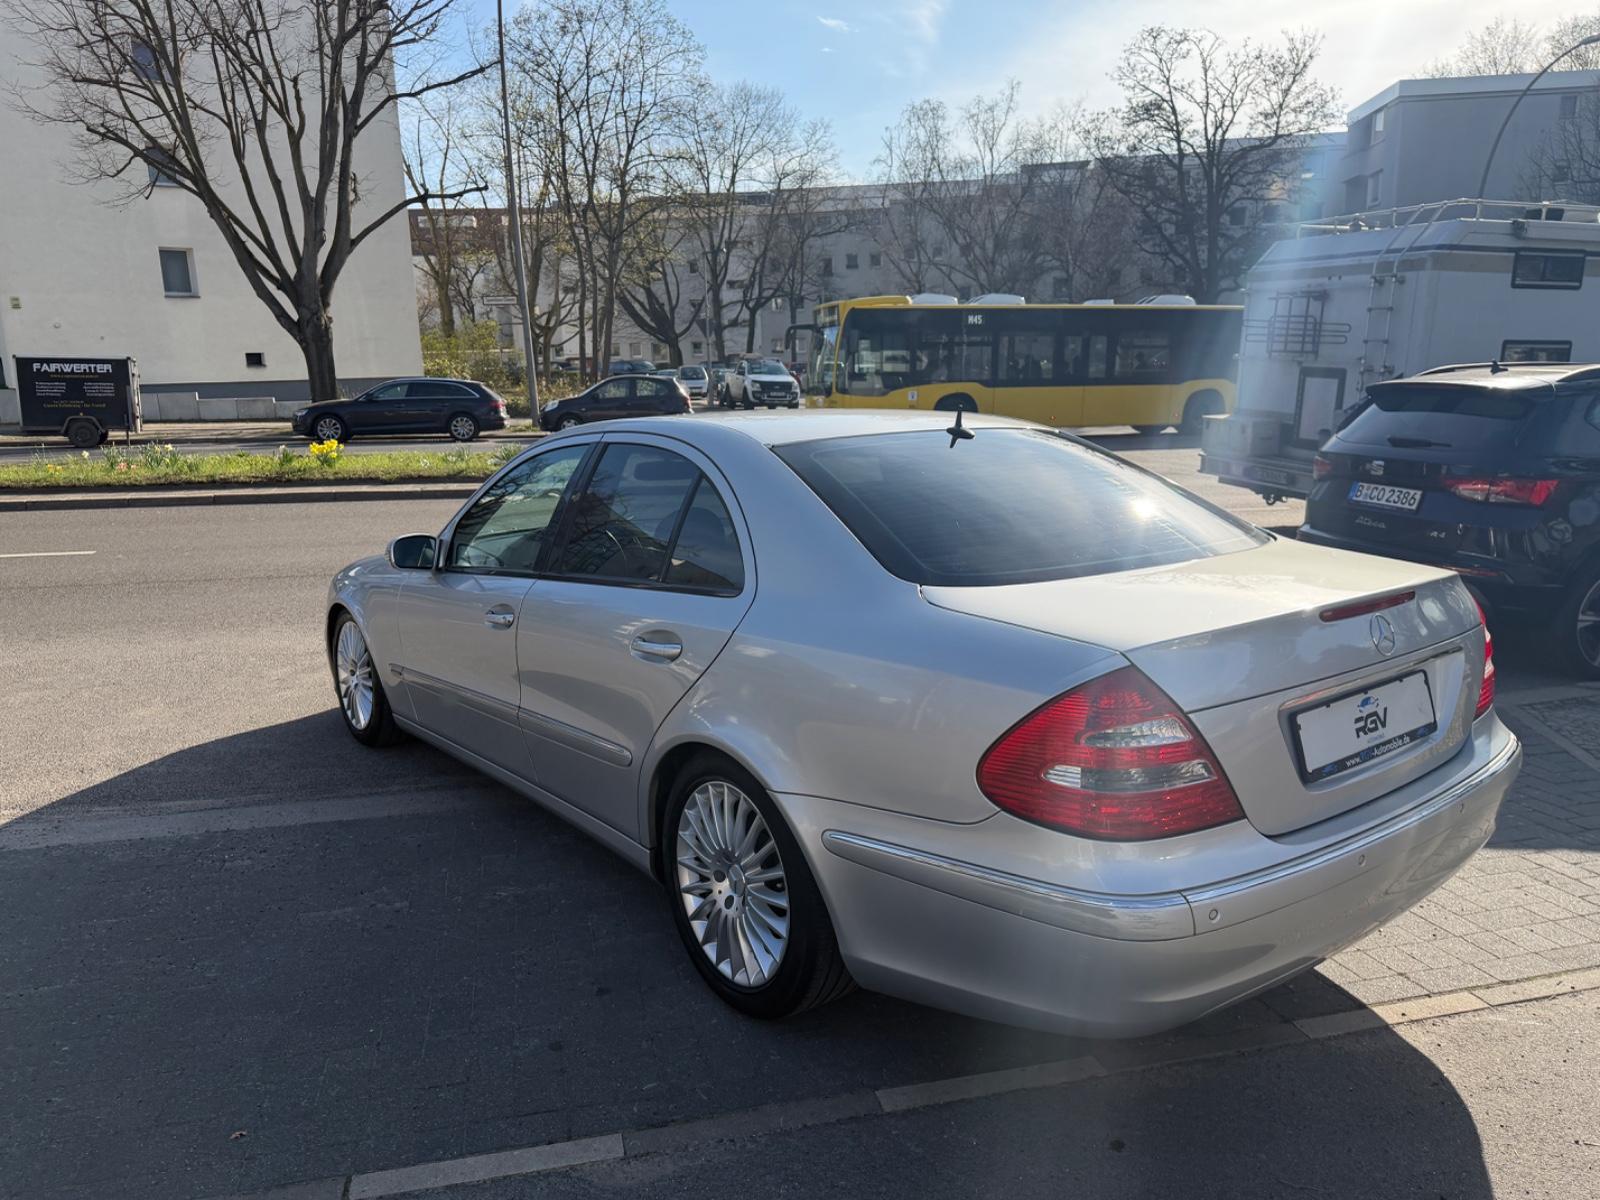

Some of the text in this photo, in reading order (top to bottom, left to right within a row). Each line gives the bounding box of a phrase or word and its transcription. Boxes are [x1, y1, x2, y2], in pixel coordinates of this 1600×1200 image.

[967, 314, 983, 325] M45
[32, 363, 112, 373] FAIRWERTER
[1355, 484, 1417, 507] B CO 2386
[1354, 706, 1388, 739] RGV
